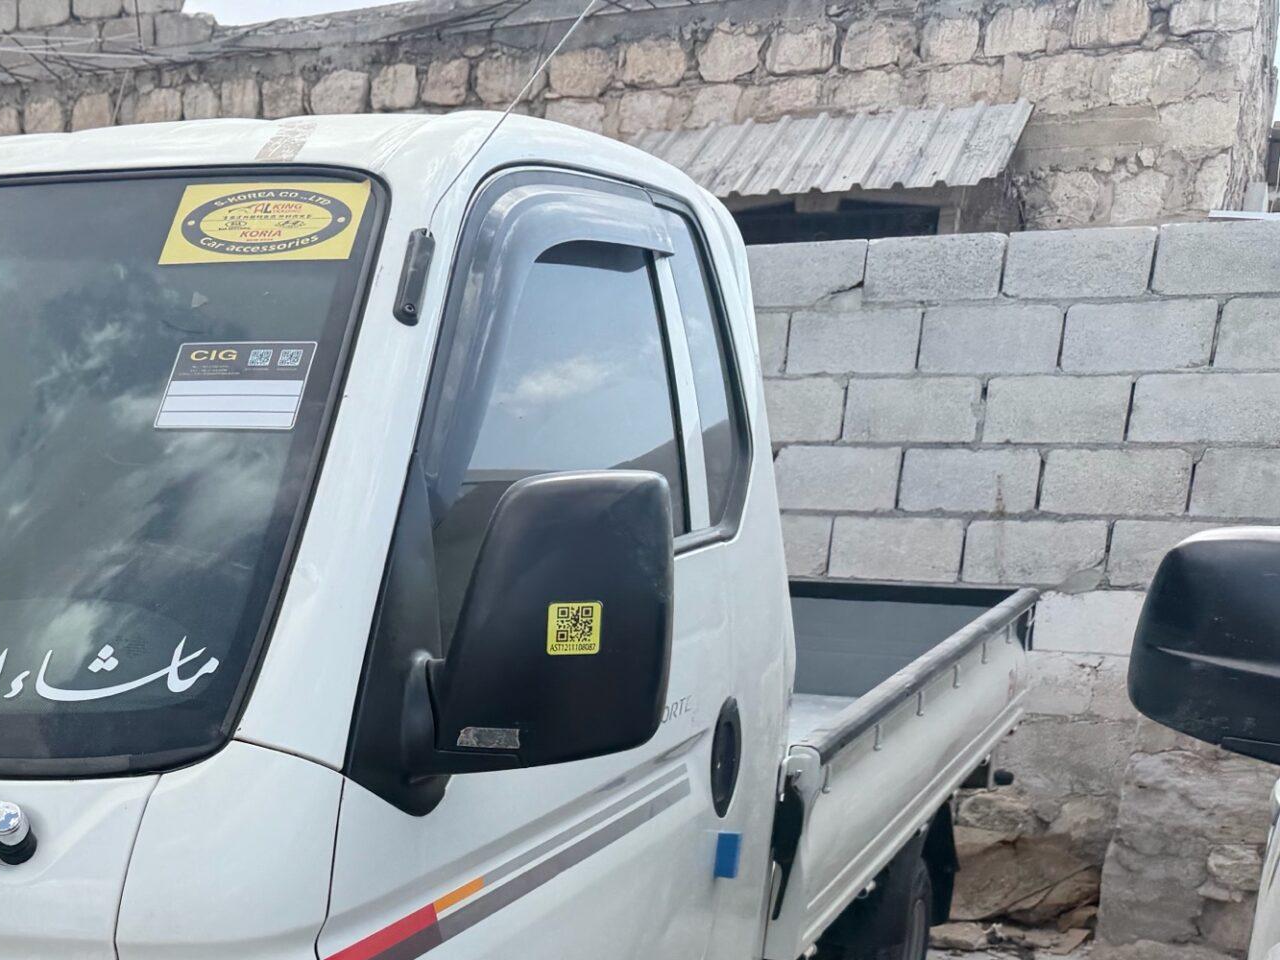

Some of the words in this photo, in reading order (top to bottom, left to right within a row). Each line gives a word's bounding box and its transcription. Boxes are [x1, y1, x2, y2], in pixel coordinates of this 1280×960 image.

[214, 191, 275, 206] S-KOREA
[240, 230, 282, 238] KORIA
[200, 236, 224, 248] Car
[226, 234, 320, 252] accessories
[190, 349, 238, 361] CIG
